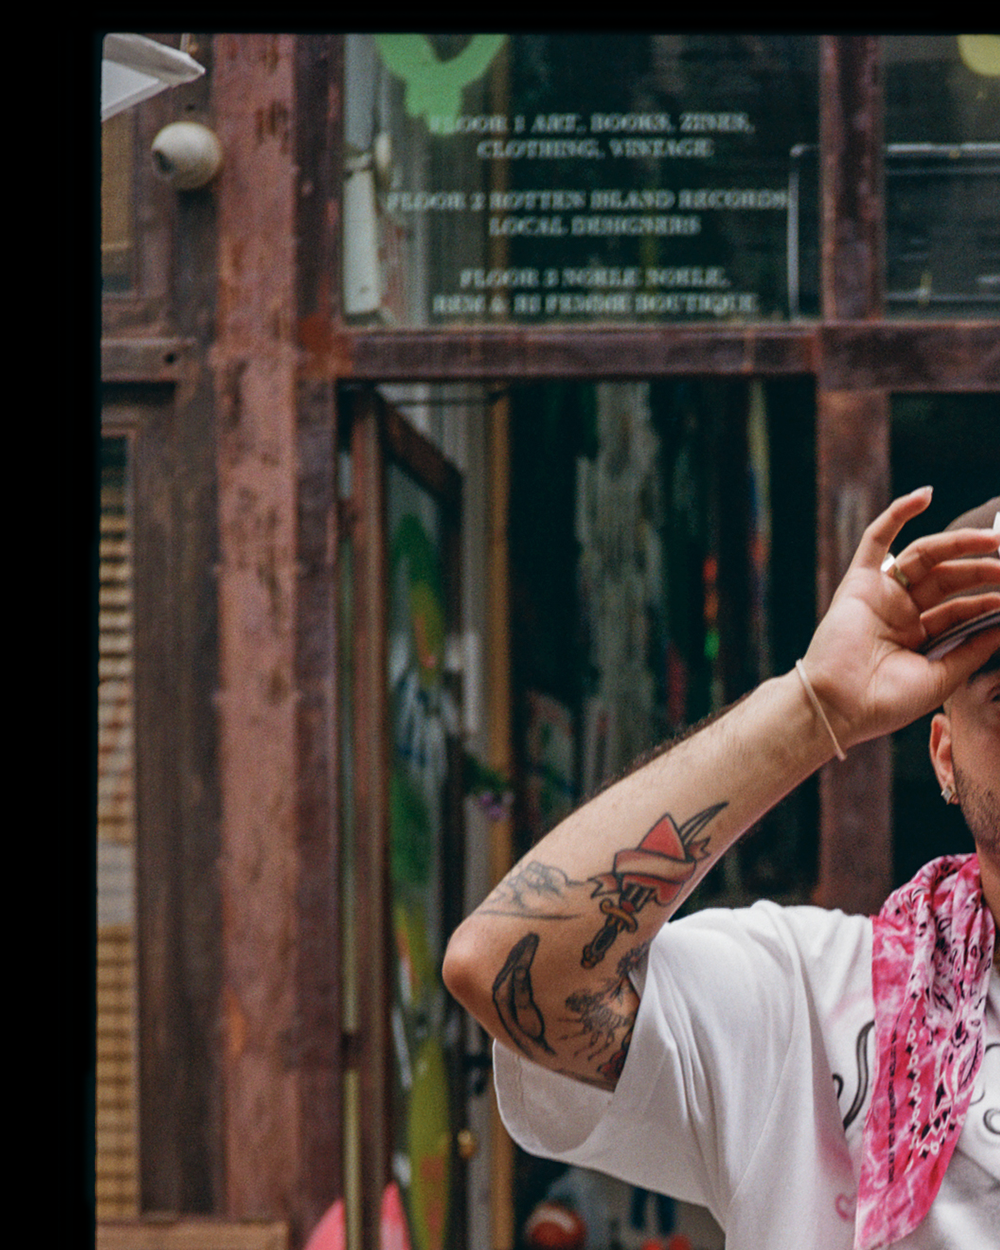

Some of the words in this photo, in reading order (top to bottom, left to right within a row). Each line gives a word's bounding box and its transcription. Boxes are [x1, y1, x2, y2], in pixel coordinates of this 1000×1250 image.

[609, 138, 715, 158] VINTAGE
[387, 191, 467, 211] FLOOR
[489, 190, 586, 211] ROTTEN
[489, 215, 570, 236] LOCAL
[571, 215, 701, 235] DESIGNERS
[460, 268, 540, 288] FLOOR
